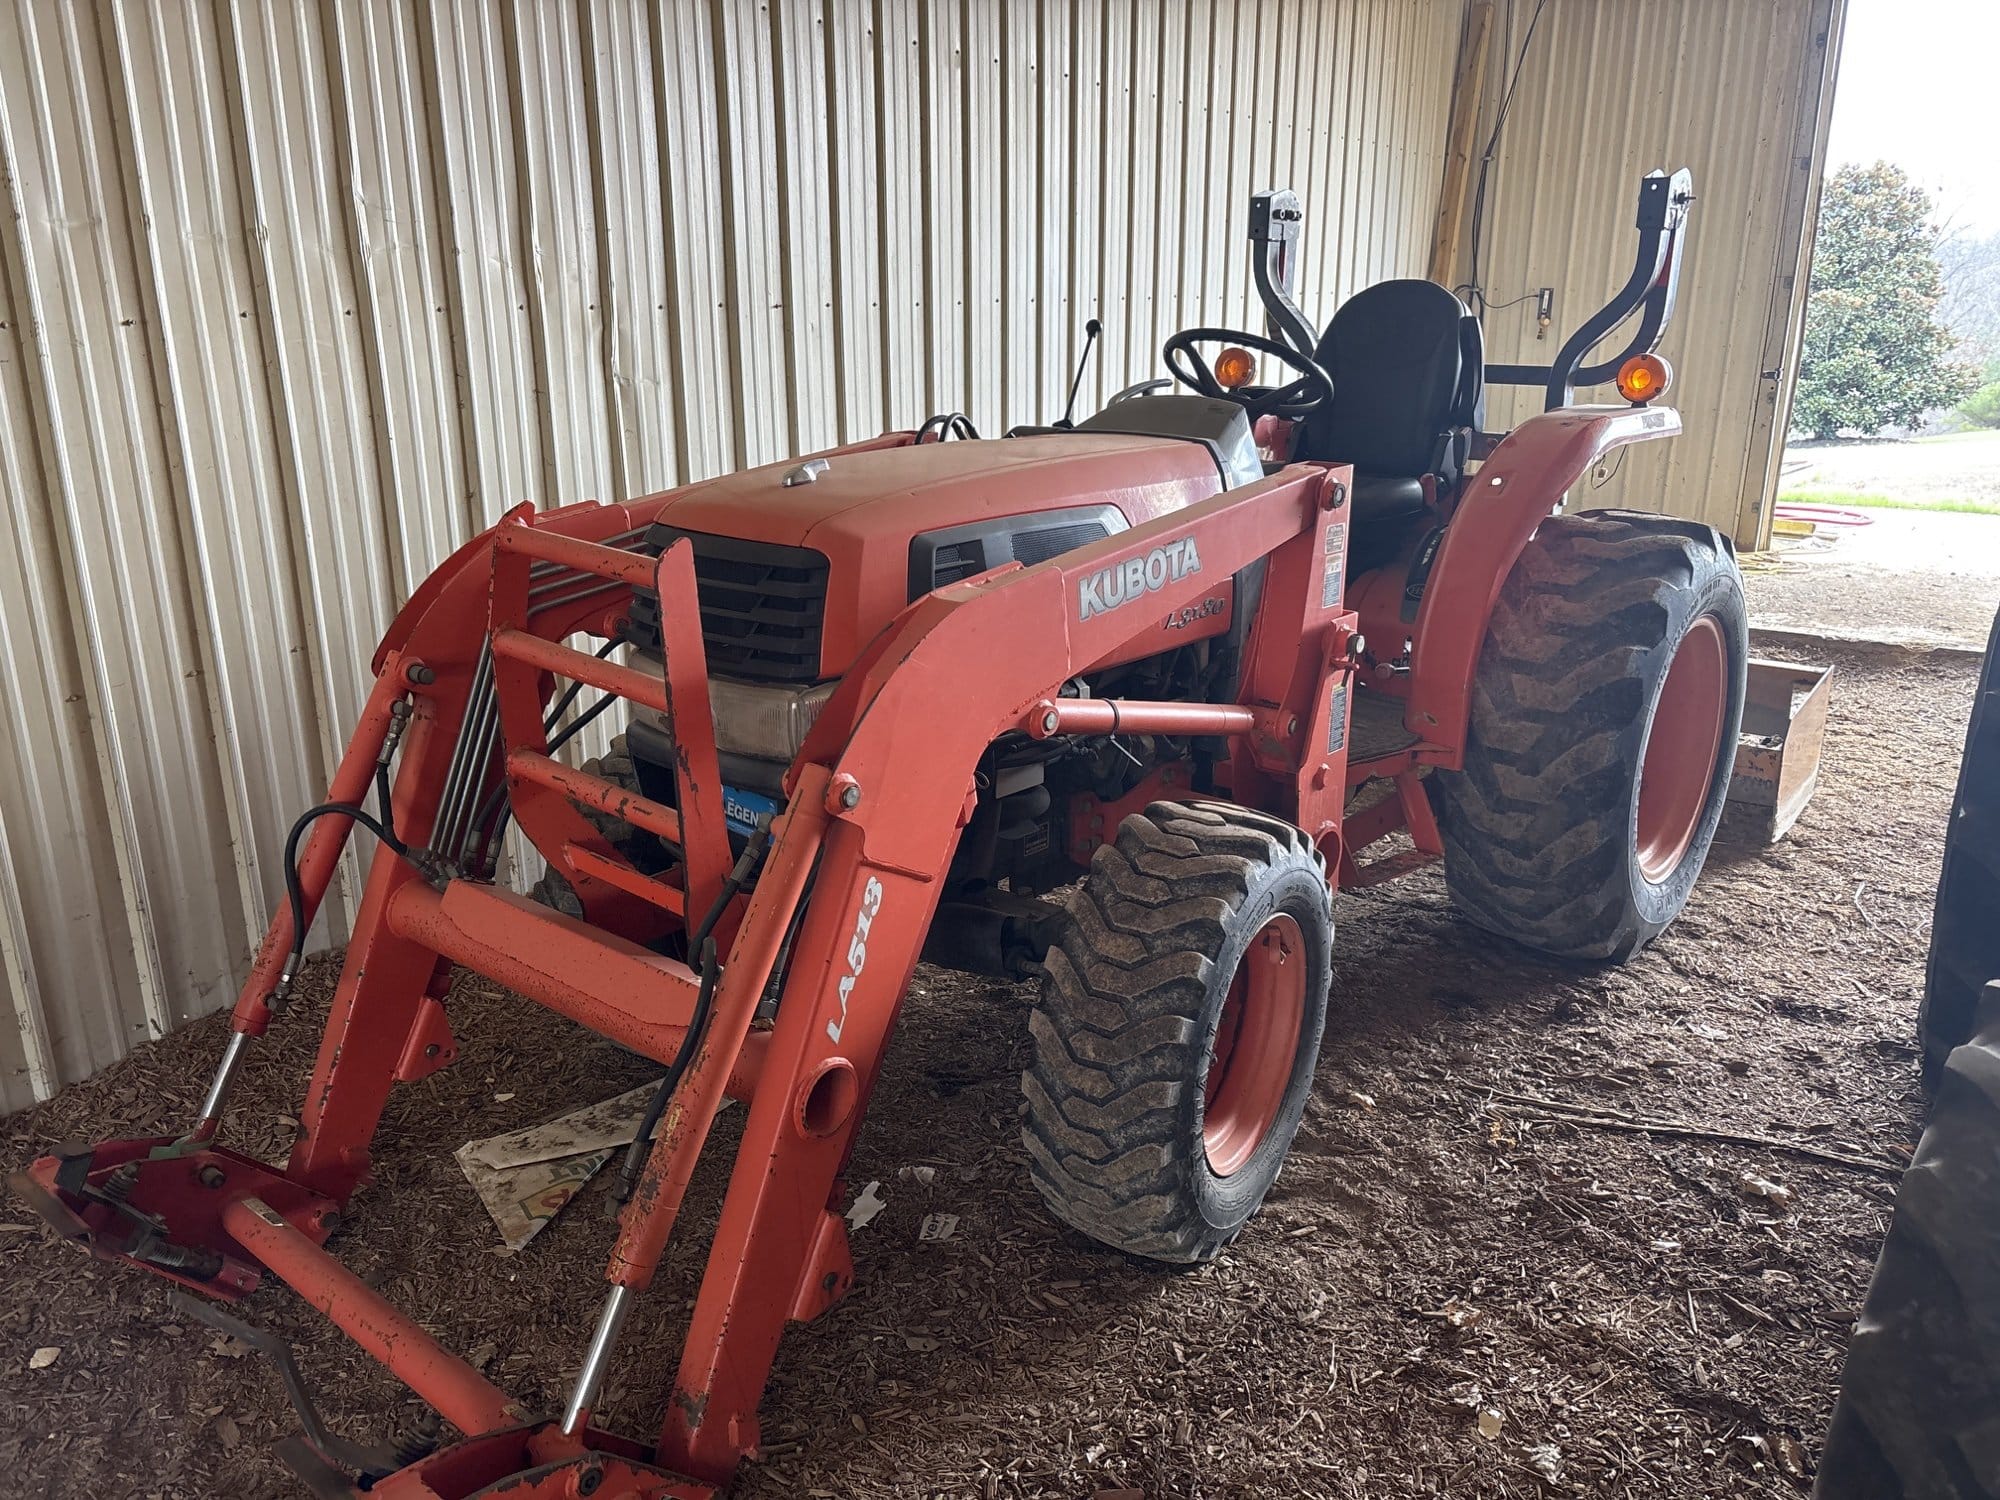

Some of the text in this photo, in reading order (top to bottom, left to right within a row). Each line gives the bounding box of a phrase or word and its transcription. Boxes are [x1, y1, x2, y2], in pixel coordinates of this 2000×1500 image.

[1079, 535, 1202, 622] KUBOTA
[724, 800, 759, 827] EGEN
[826, 876, 883, 1046] LA513
